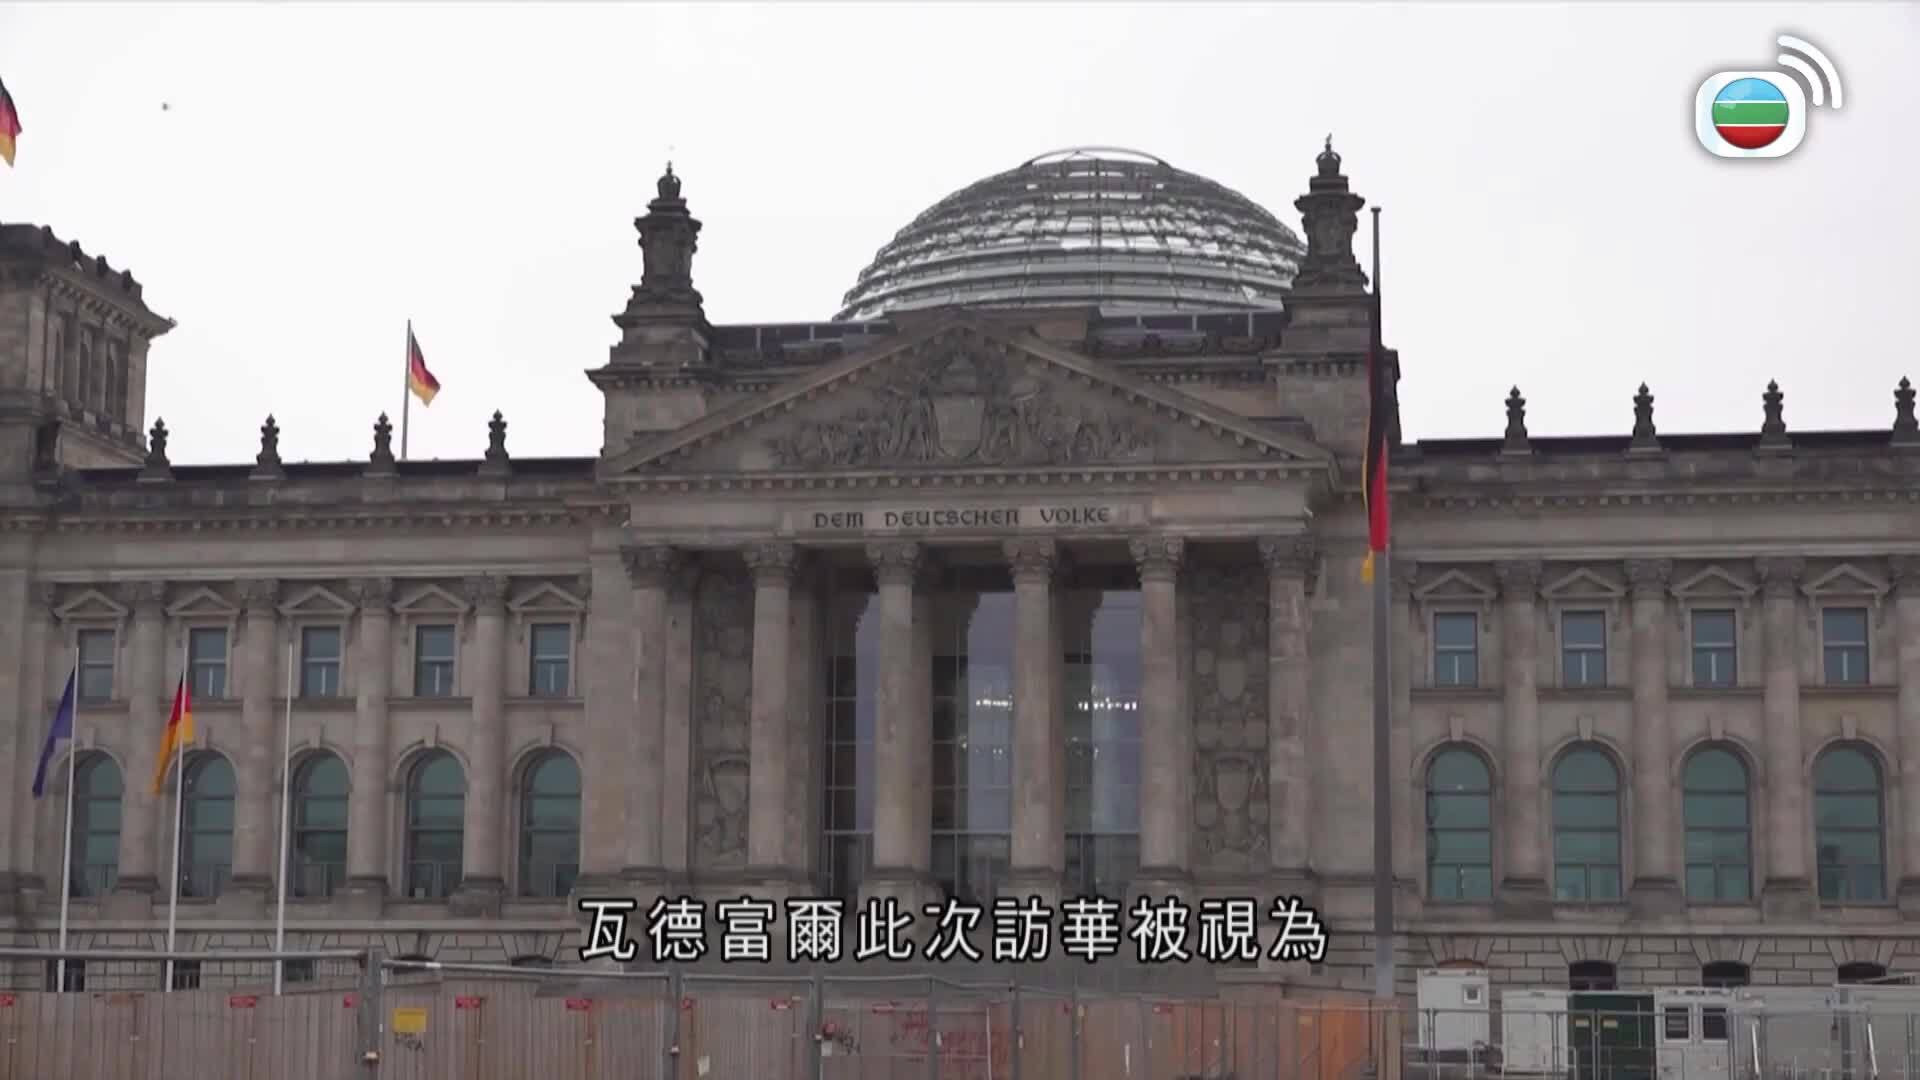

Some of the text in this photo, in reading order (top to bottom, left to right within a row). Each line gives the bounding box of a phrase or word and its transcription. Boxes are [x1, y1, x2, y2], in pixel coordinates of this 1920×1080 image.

[814, 507, 1111, 528] DEM DEUTSCHEN VOLKE
